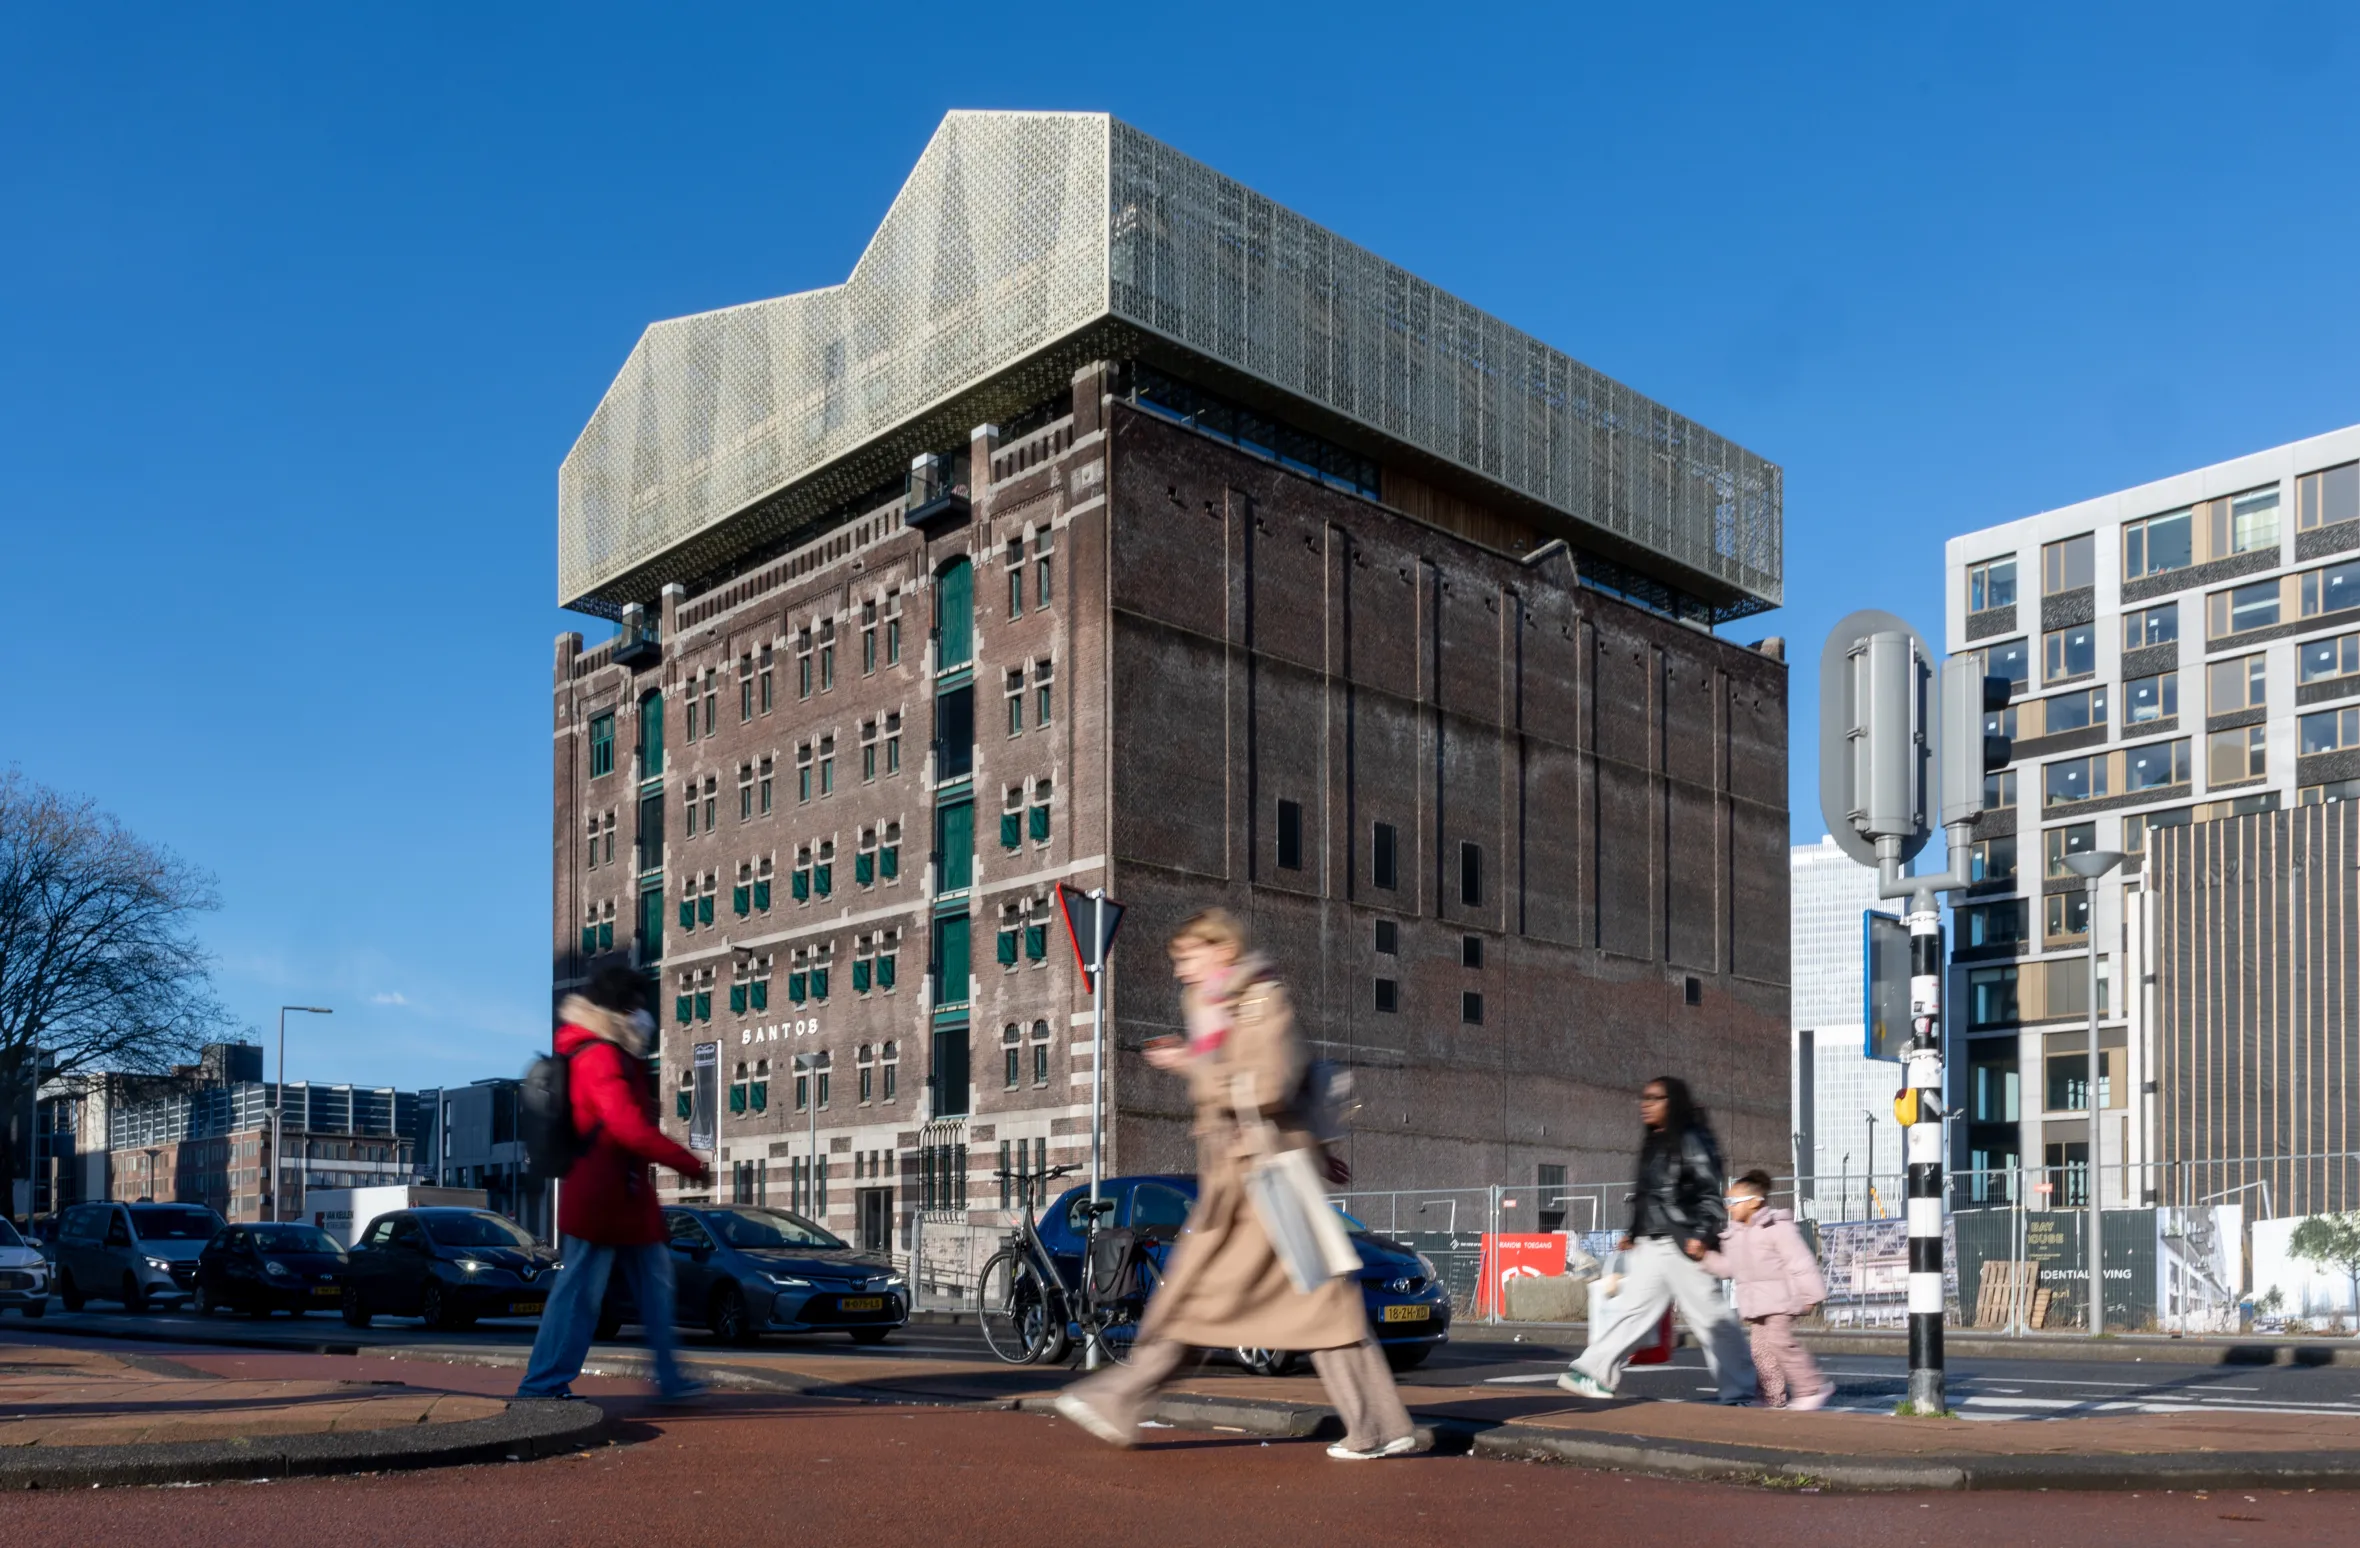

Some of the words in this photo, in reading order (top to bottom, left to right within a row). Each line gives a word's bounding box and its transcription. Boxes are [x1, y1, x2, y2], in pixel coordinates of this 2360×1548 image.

[741, 1018, 819, 1045] SANTOS
[2040, 1269, 2090, 1280] IDENTIAL
[2102, 1269, 2132, 1279] VING
